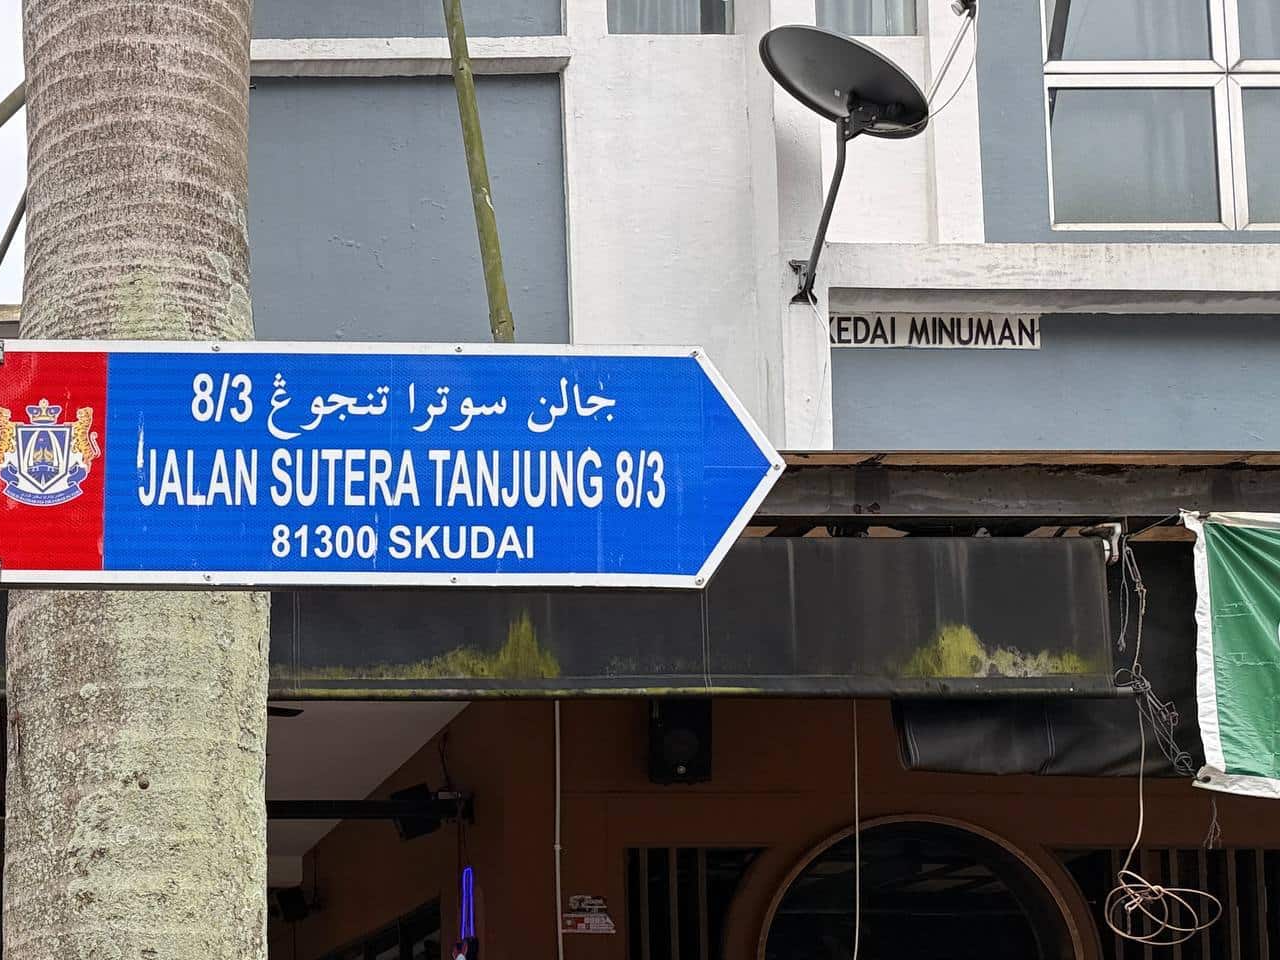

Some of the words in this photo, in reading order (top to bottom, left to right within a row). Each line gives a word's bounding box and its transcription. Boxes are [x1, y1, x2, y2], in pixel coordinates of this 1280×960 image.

[909, 317, 1035, 346] MINUMAN
[192, 373, 253, 423] 8/3
[409, 382, 507, 432] سوترا
[528, 377, 616, 432] جالن
[138, 449, 258, 507] JALAN
[271, 448, 421, 507] SUTERA
[429, 449, 603, 508] TANJUNG
[616, 450, 666, 508] 8/3
[272, 525, 377, 559] 81300
[389, 525, 535, 560] SKUDAI
